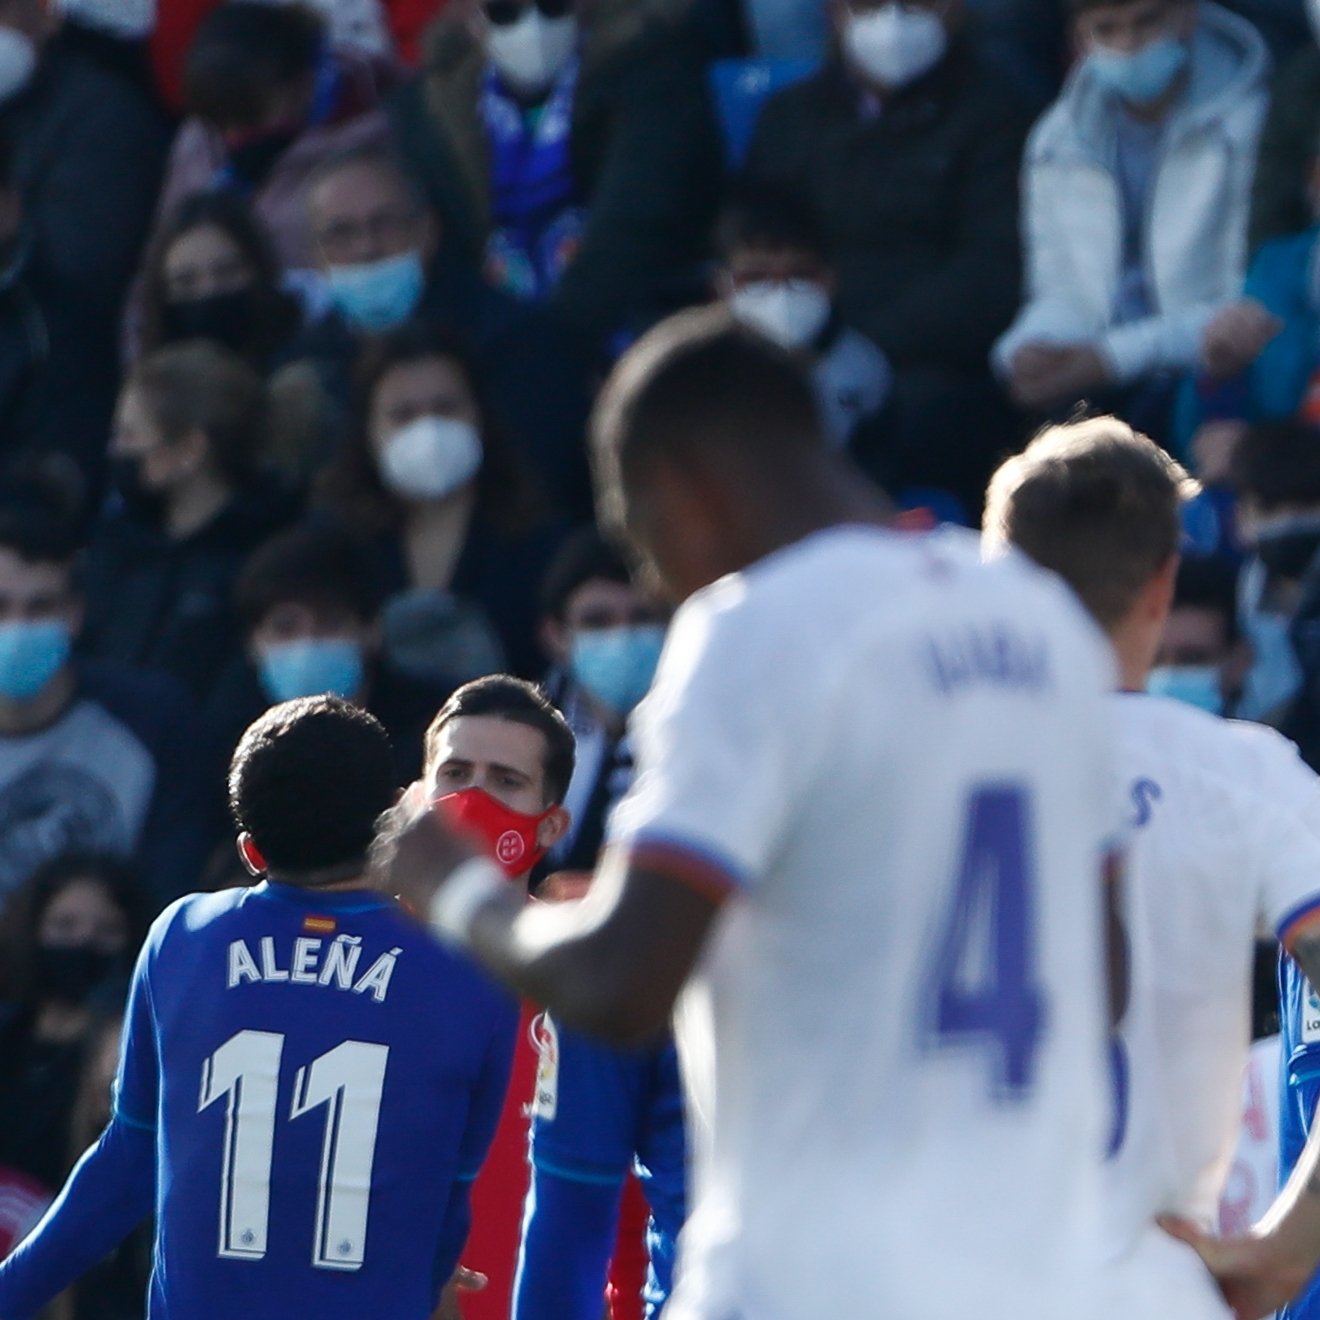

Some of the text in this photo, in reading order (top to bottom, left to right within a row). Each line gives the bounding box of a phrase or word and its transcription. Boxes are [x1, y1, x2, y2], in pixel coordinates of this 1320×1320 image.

[226, 936, 403, 1003] ALEÑÁ
[919, 778, 1049, 1105] 4
[198, 1030, 390, 1272] 11
